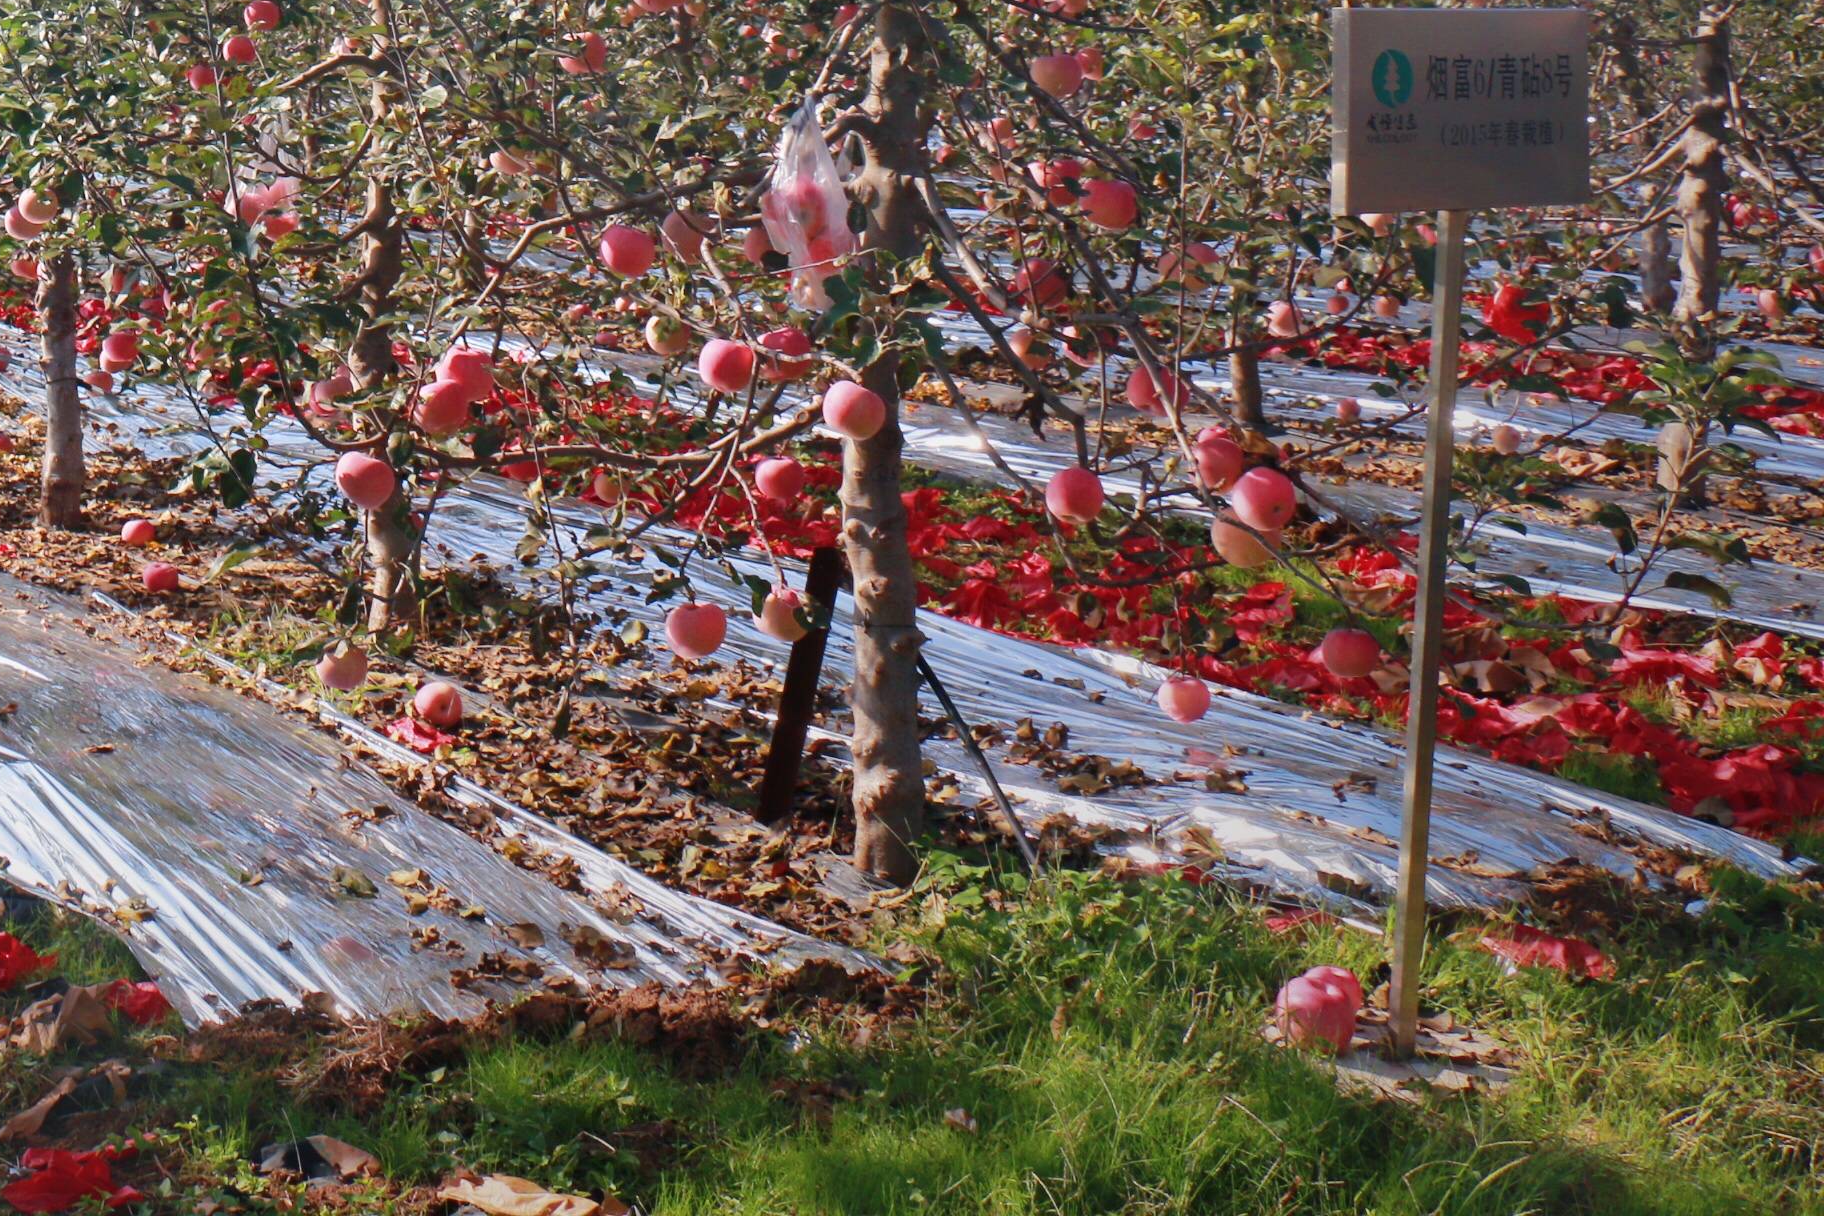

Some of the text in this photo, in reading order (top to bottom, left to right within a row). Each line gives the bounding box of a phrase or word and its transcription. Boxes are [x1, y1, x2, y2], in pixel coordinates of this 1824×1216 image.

[1426, 52, 1573, 101] 烟富6/青砧8号
